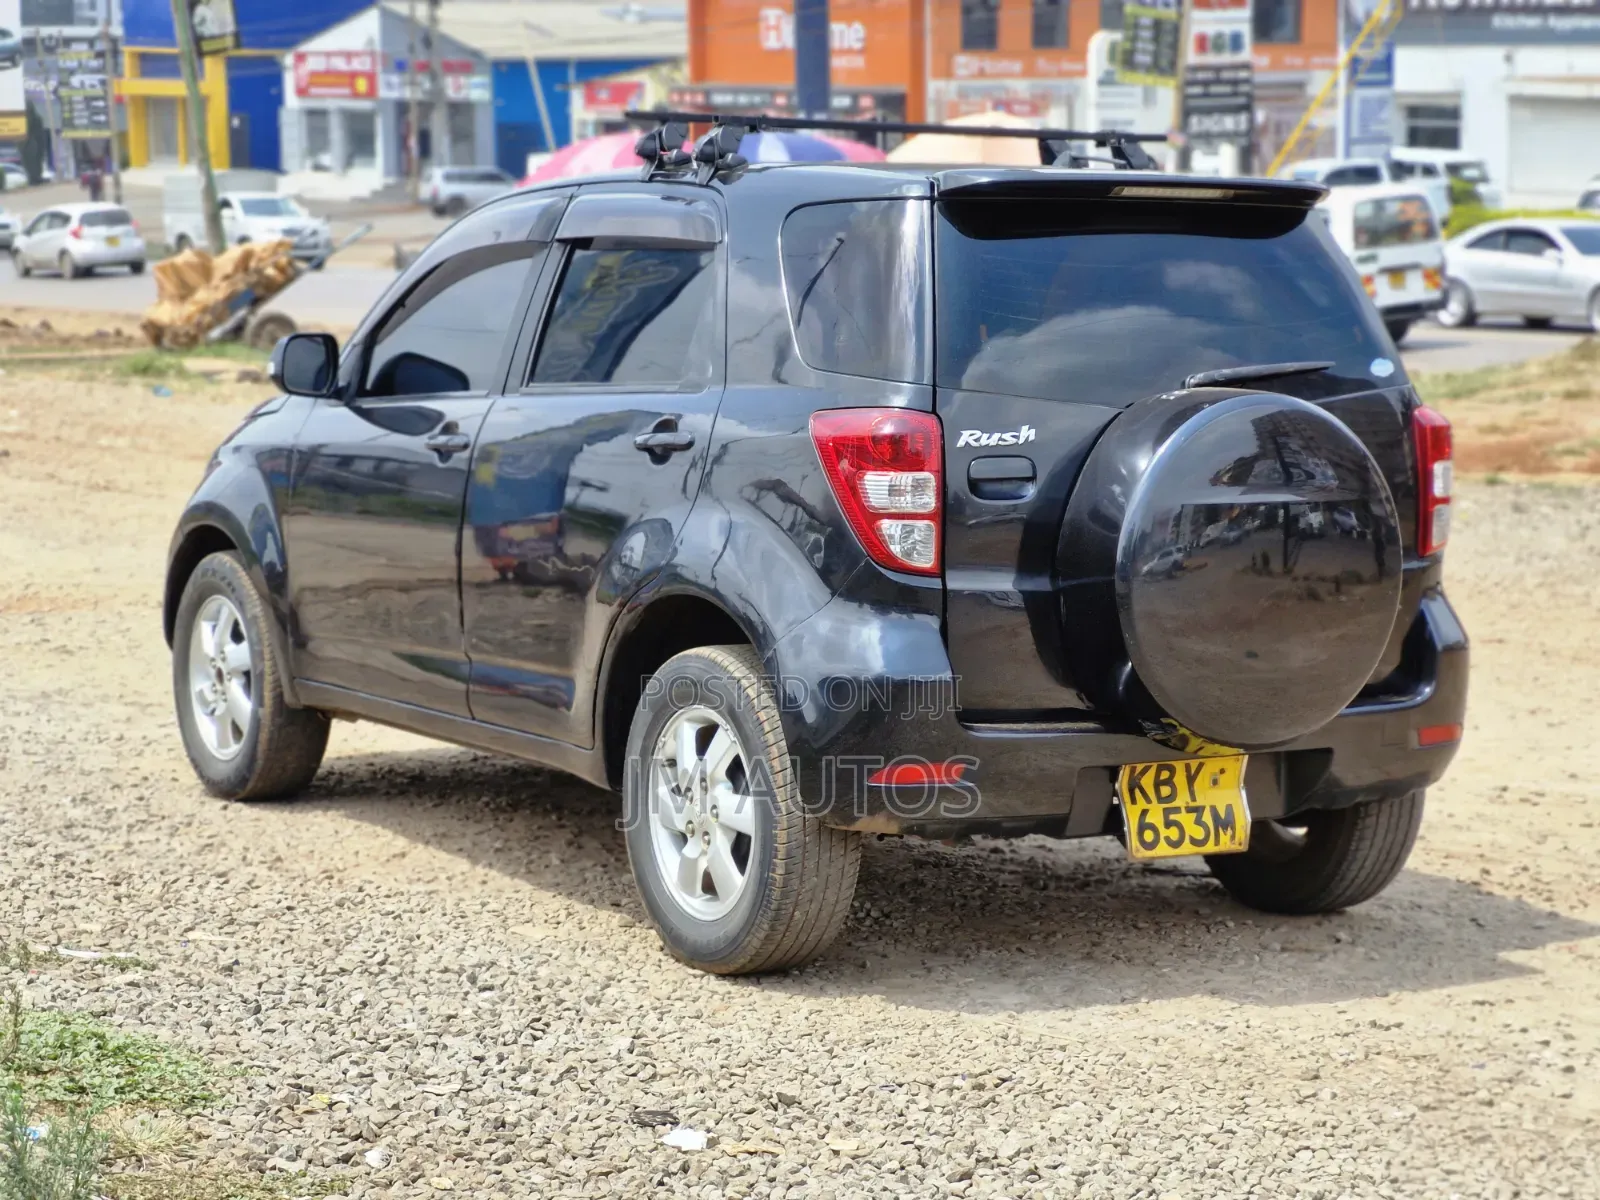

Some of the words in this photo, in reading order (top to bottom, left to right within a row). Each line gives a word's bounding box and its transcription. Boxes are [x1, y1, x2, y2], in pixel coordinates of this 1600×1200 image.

[956, 424, 1036, 448] Rush
[1127, 761, 1205, 805] KBY
[1137, 803, 1236, 851] 653M
